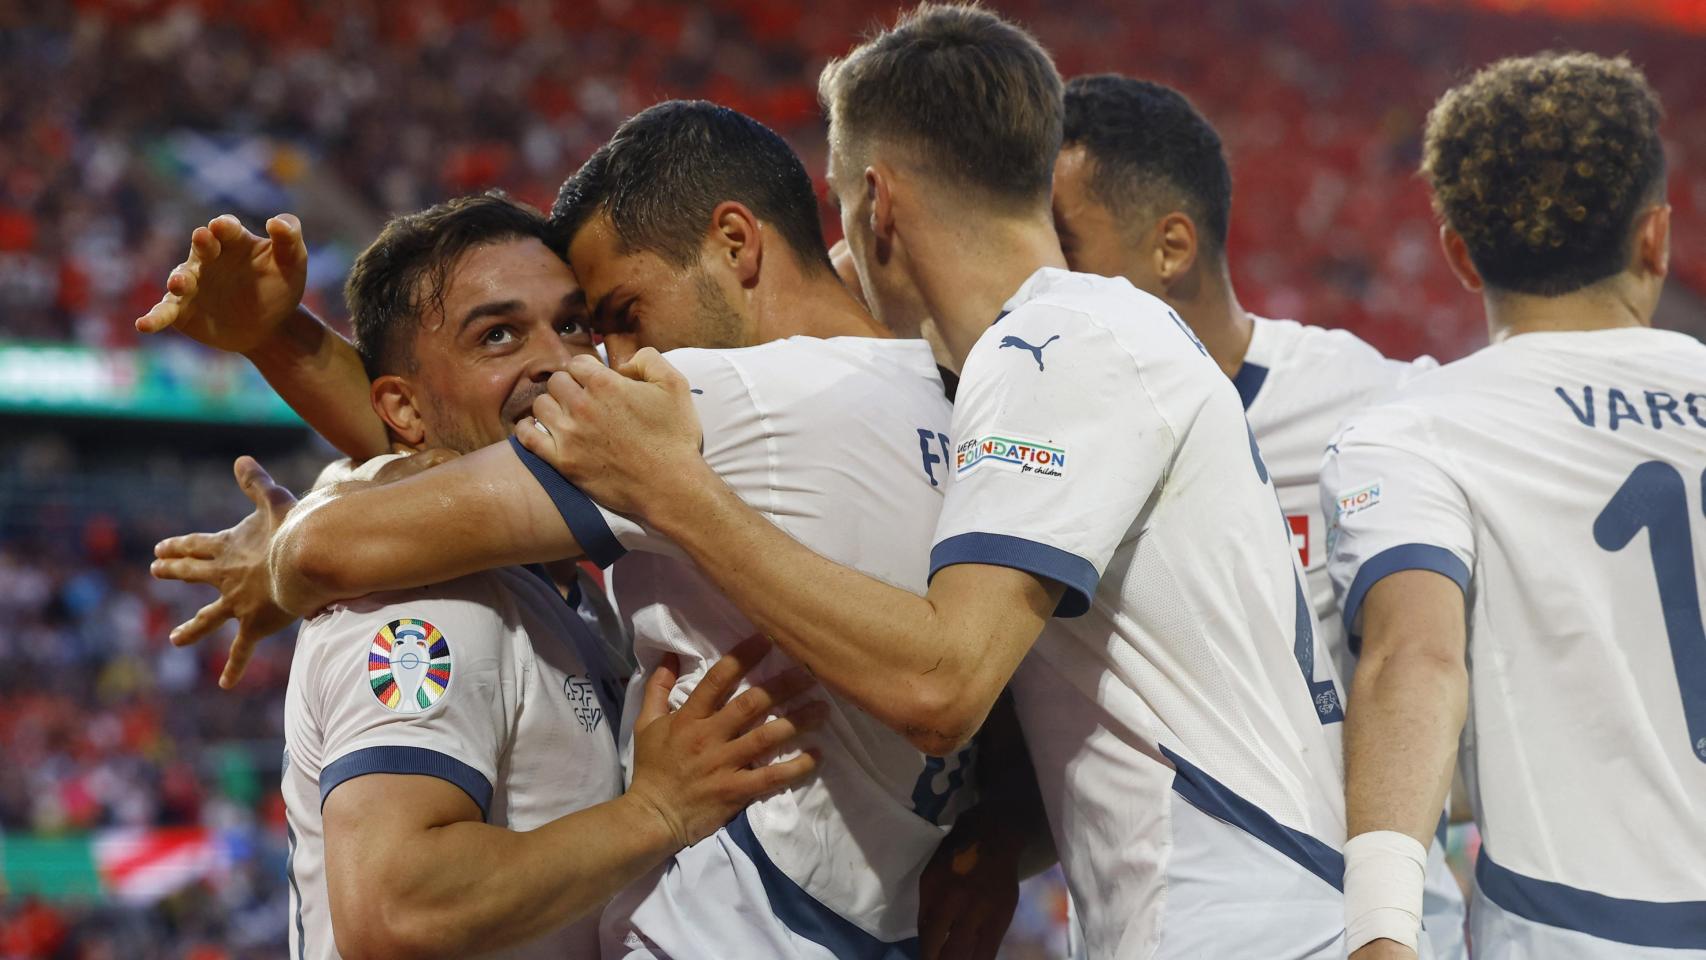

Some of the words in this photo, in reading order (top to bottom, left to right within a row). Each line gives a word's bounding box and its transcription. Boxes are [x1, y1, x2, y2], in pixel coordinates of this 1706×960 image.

[957, 438, 977, 453] UEFA
[1021, 463, 1033, 473] for
[1034, 466, 1062, 477] children
[1593, 460, 1706, 764] 1
